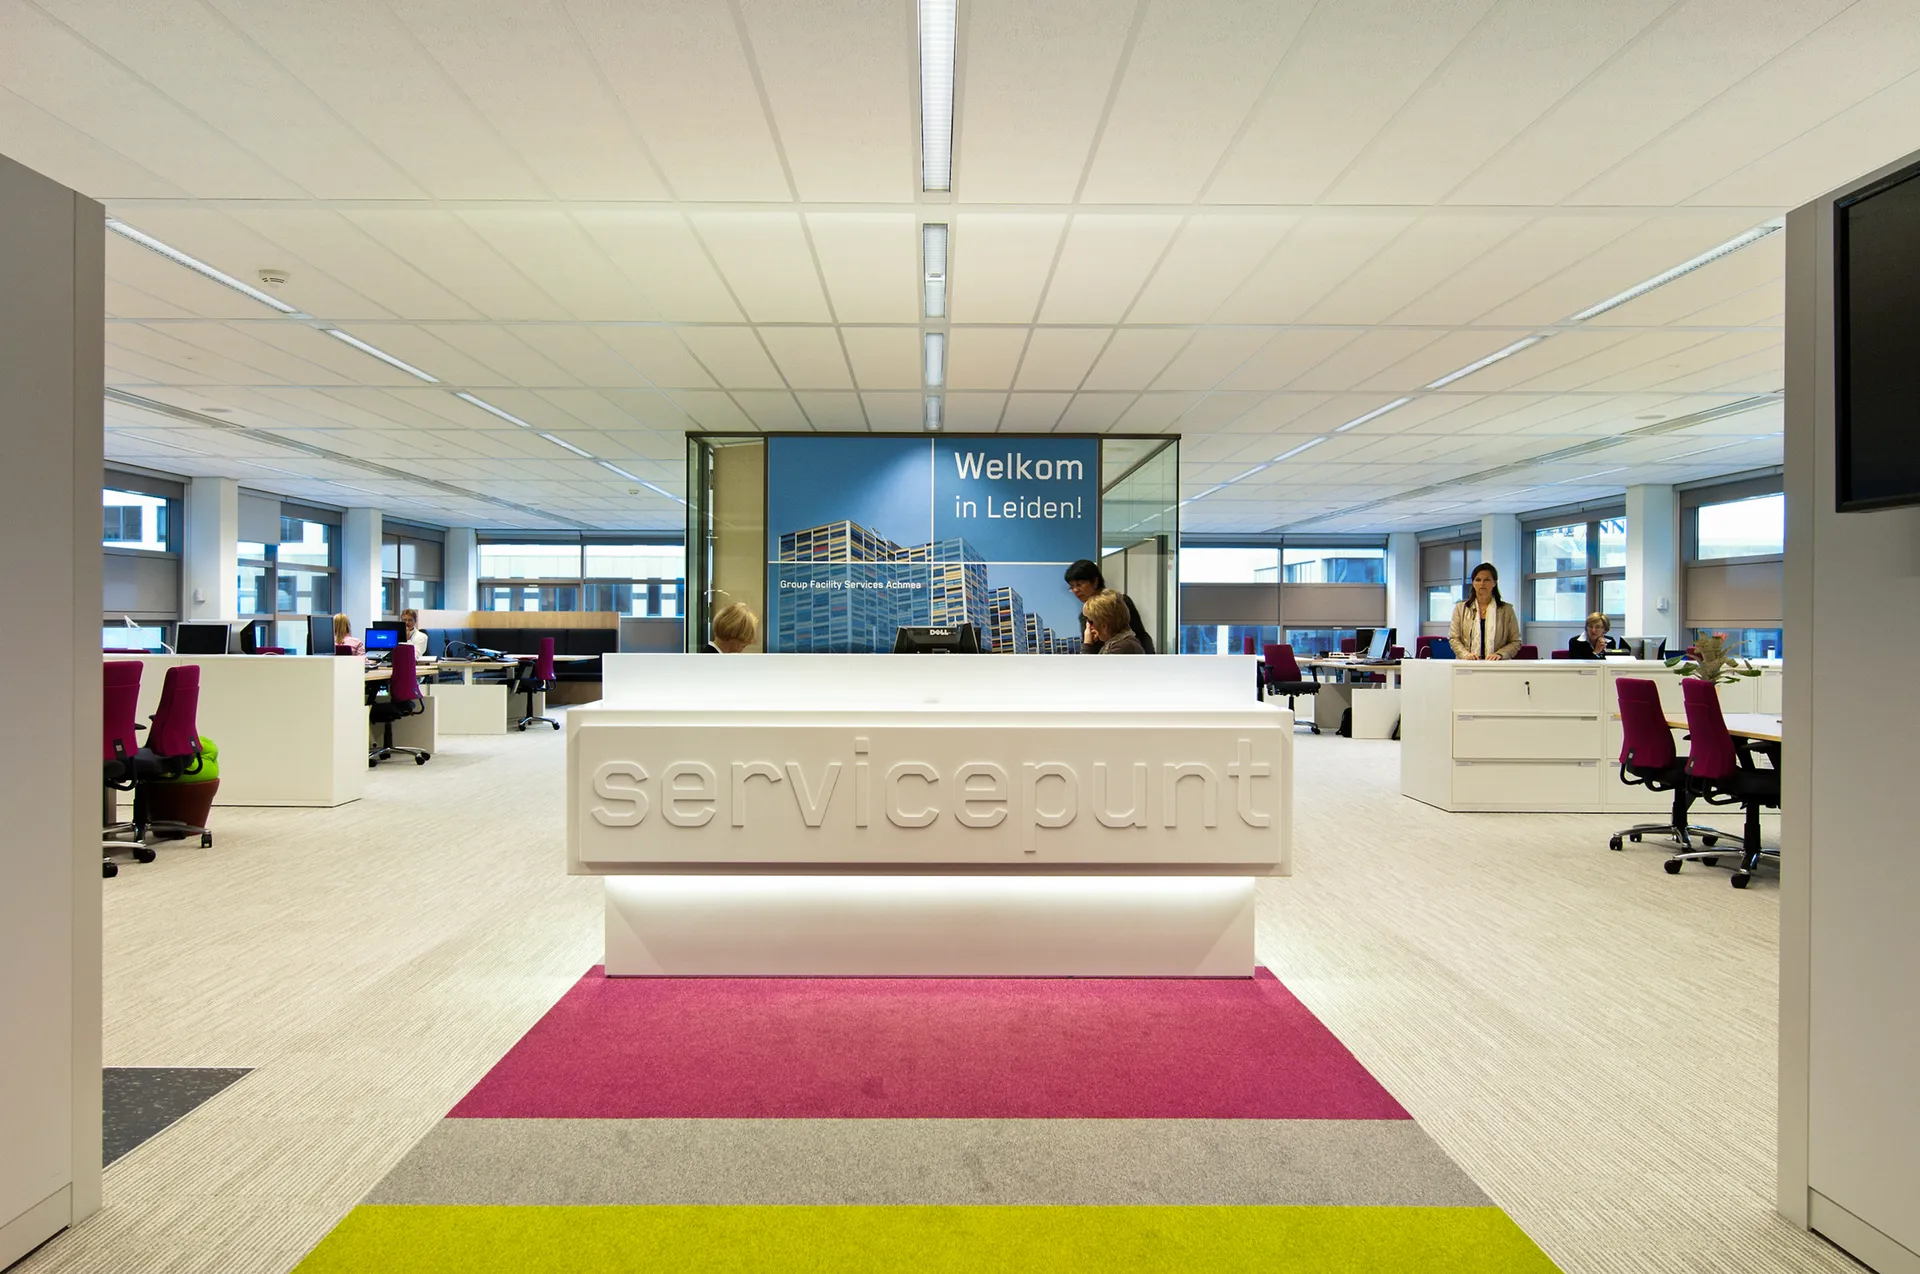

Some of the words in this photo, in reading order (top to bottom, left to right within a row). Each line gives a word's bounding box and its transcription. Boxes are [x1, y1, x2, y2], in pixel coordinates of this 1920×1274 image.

[954, 452, 1083, 480] Welkom
[955, 495, 977, 518] in
[987, 495, 1082, 519] Leiden!
[780, 580, 808, 590] Group
[810, 580, 842, 590] Facility
[844, 580, 884, 589] Services
[885, 580, 922, 589] Achmea
[590, 736, 1273, 854] servicepunt
